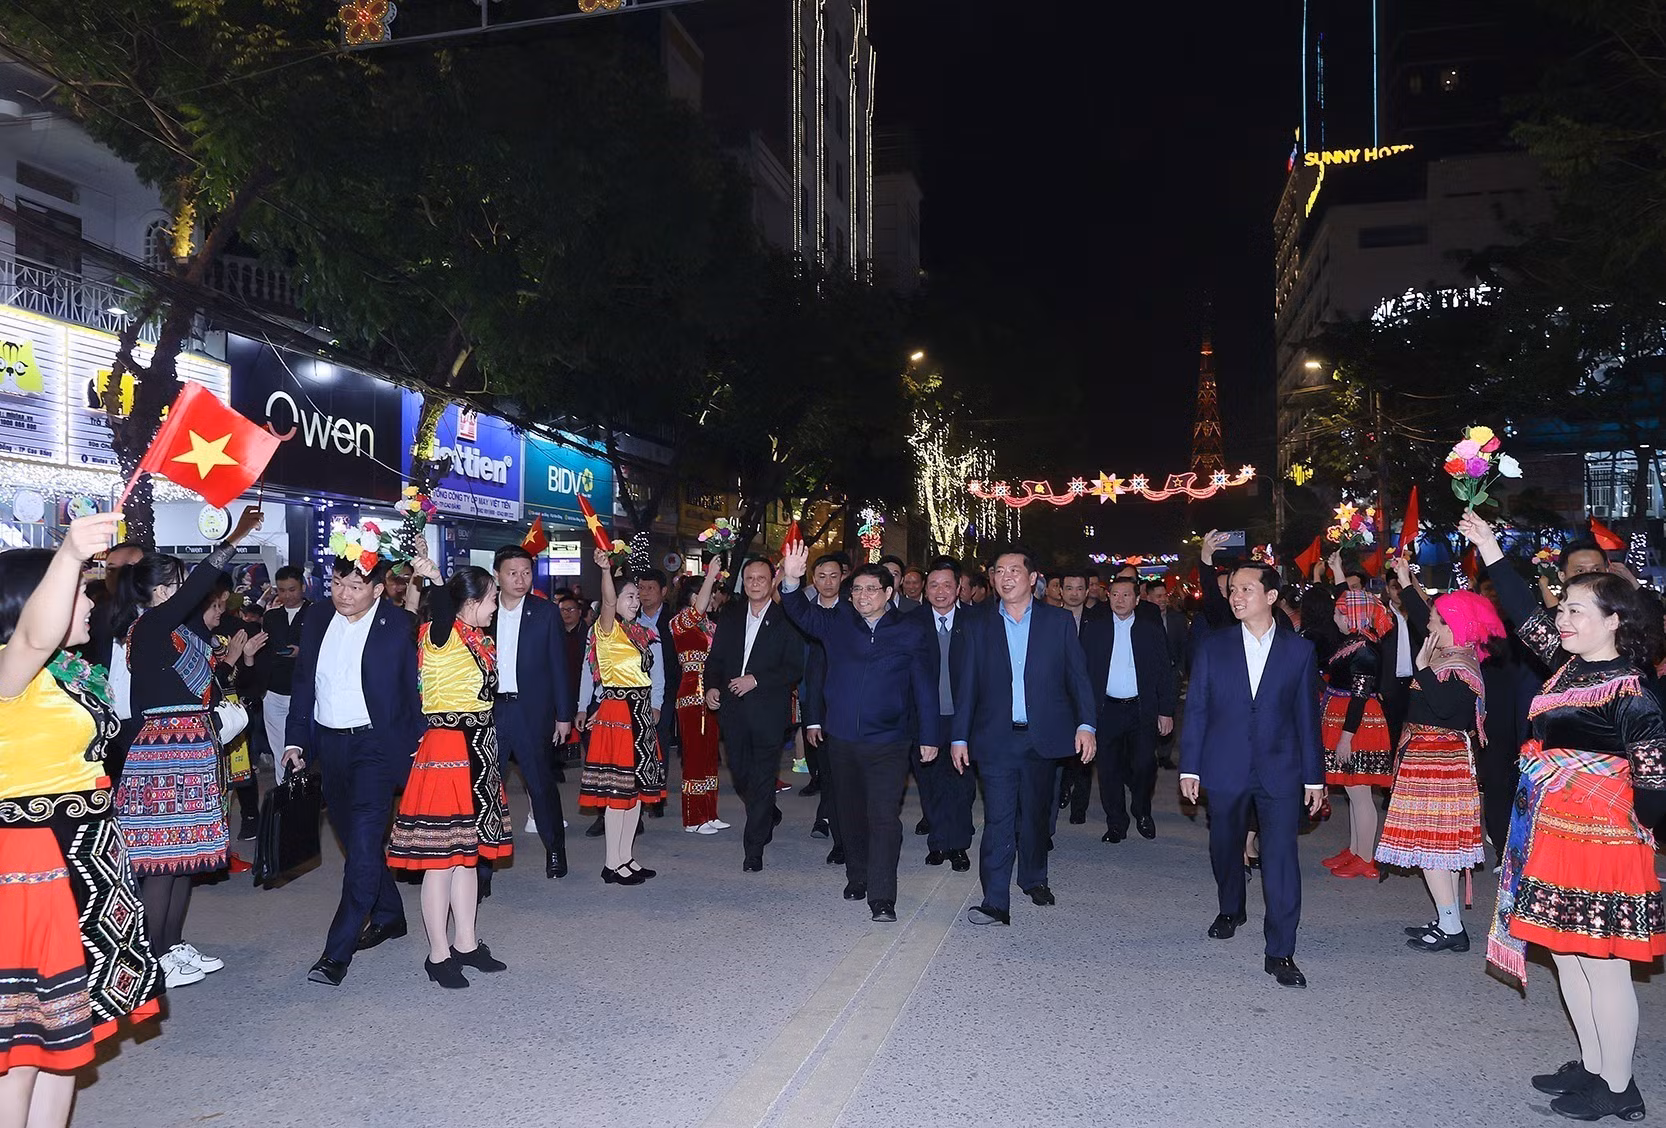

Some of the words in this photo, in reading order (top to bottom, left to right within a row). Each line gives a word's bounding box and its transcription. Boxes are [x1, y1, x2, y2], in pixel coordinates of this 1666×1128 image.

[1304, 149, 1361, 167] SUNNY
[1364, 144, 1414, 162] HOT
[265, 391, 375, 460] Owen
[548, 465, 583, 496] BIDV
